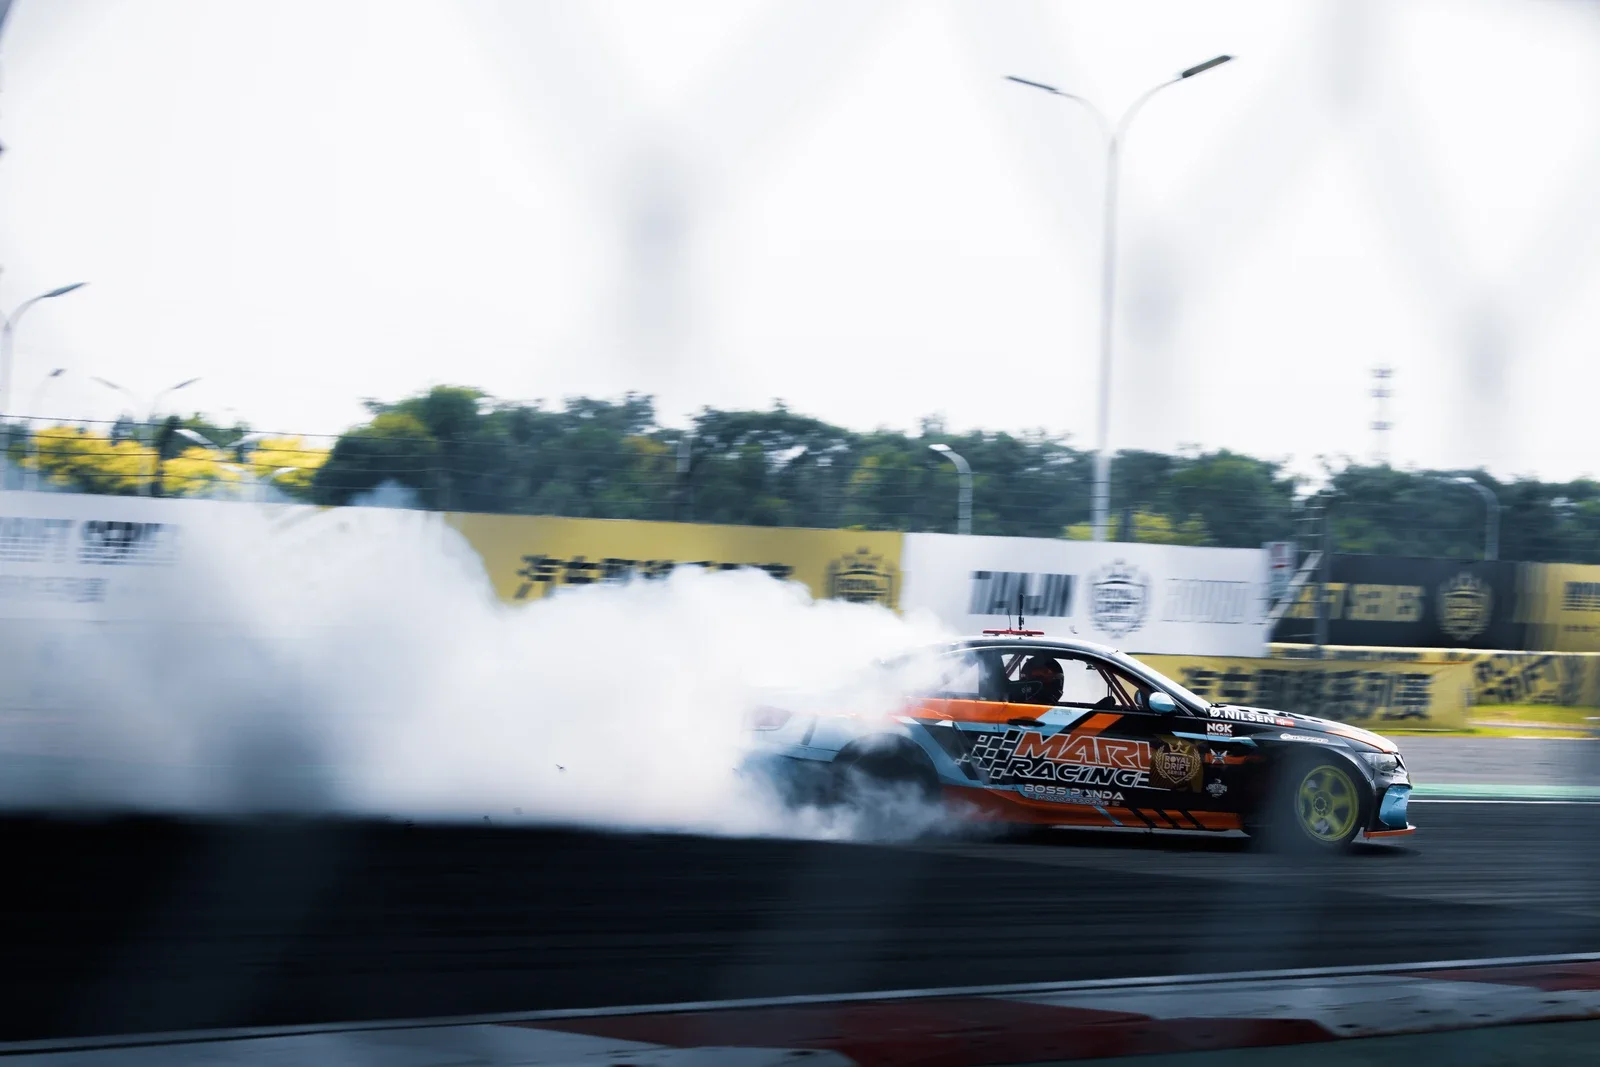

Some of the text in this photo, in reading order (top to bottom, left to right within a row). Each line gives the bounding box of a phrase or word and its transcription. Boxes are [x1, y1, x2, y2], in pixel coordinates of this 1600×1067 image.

[1206, 723, 1233, 733] NGK
[1164, 755, 1191, 764] ROYAL
[1163, 762, 1191, 772] DRIFT
[1004, 757, 1140, 788] RACING
[1024, 784, 1125, 801] BOSS PANDA
